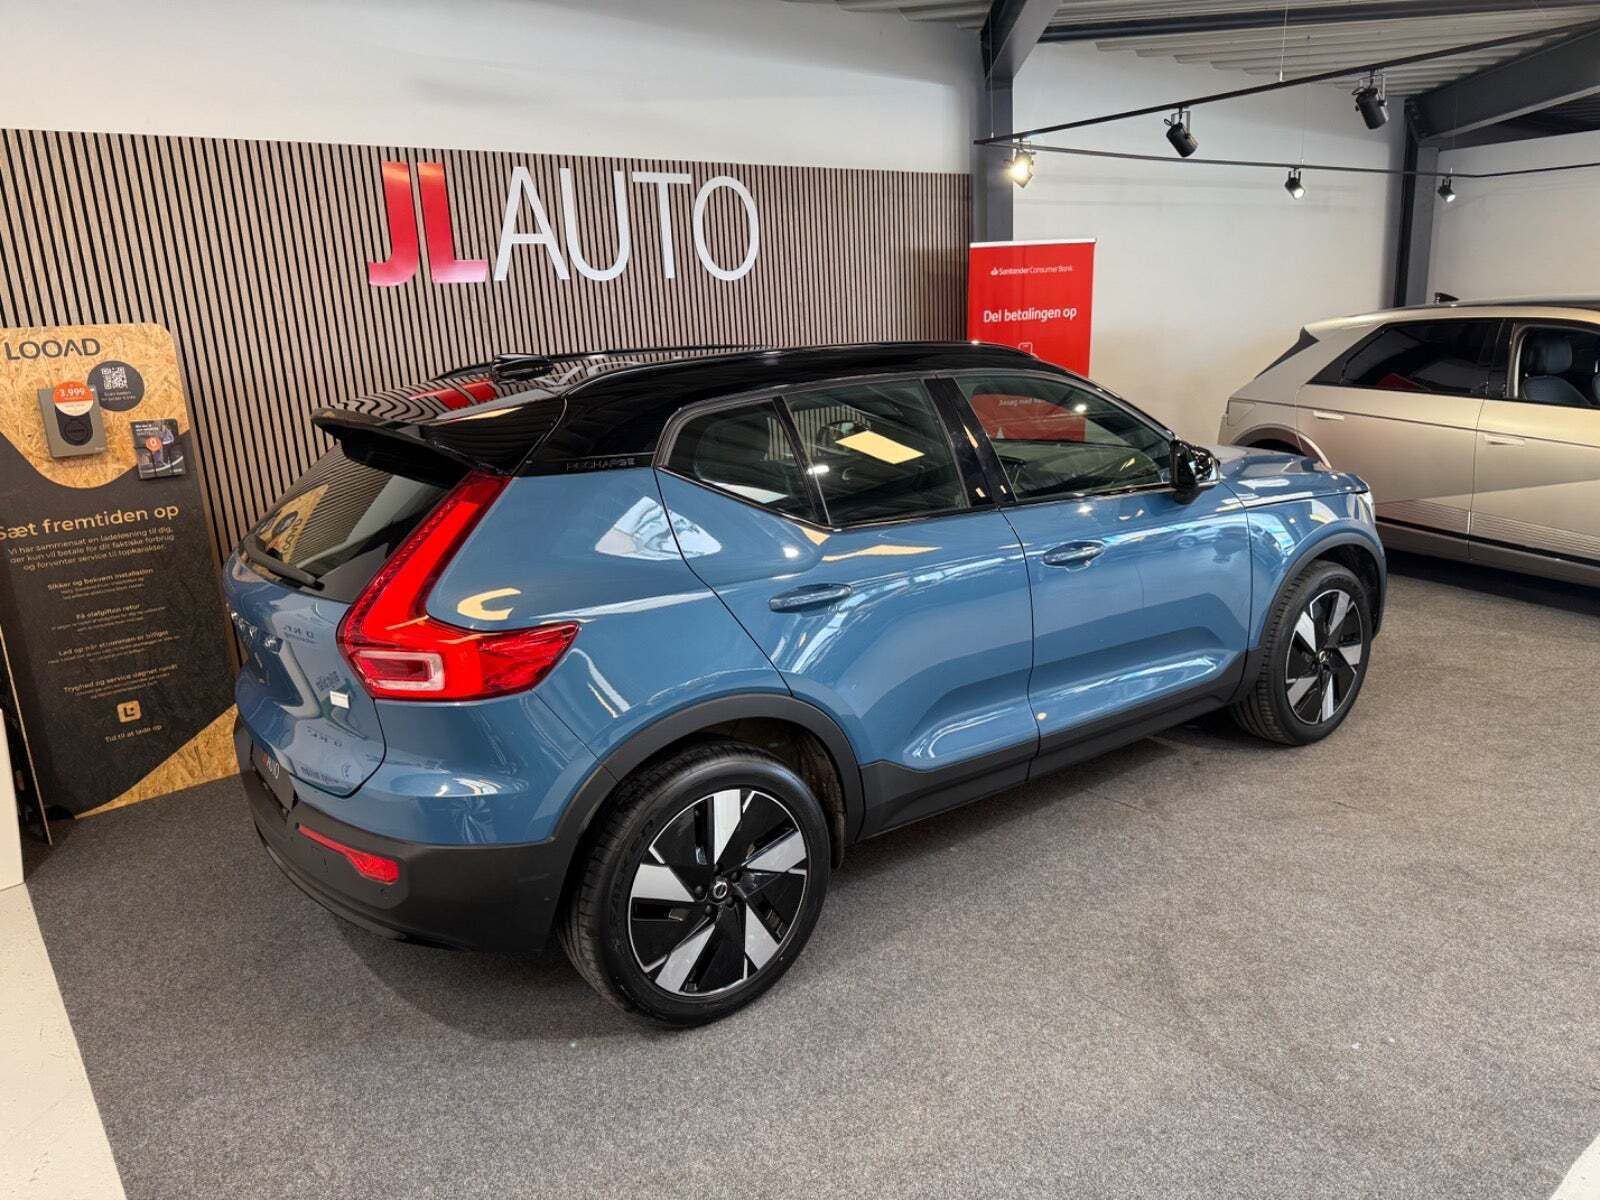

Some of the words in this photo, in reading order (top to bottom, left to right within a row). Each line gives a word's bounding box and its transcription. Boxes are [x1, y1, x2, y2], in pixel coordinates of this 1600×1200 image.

[368, 160, 489, 288] JL
[493, 165, 760, 282] AUTO
[1058, 264, 1073, 273] Bank
[983, 310, 1003, 323] Del
[1004, 307, 1062, 323] betalingen
[1062, 307, 1078, 321] op
[3, 337, 101, 361] LOOAD
[58, 387, 86, 398] 3.999
[42, 509, 150, 535] fremtiden
[153, 505, 179, 521] op
